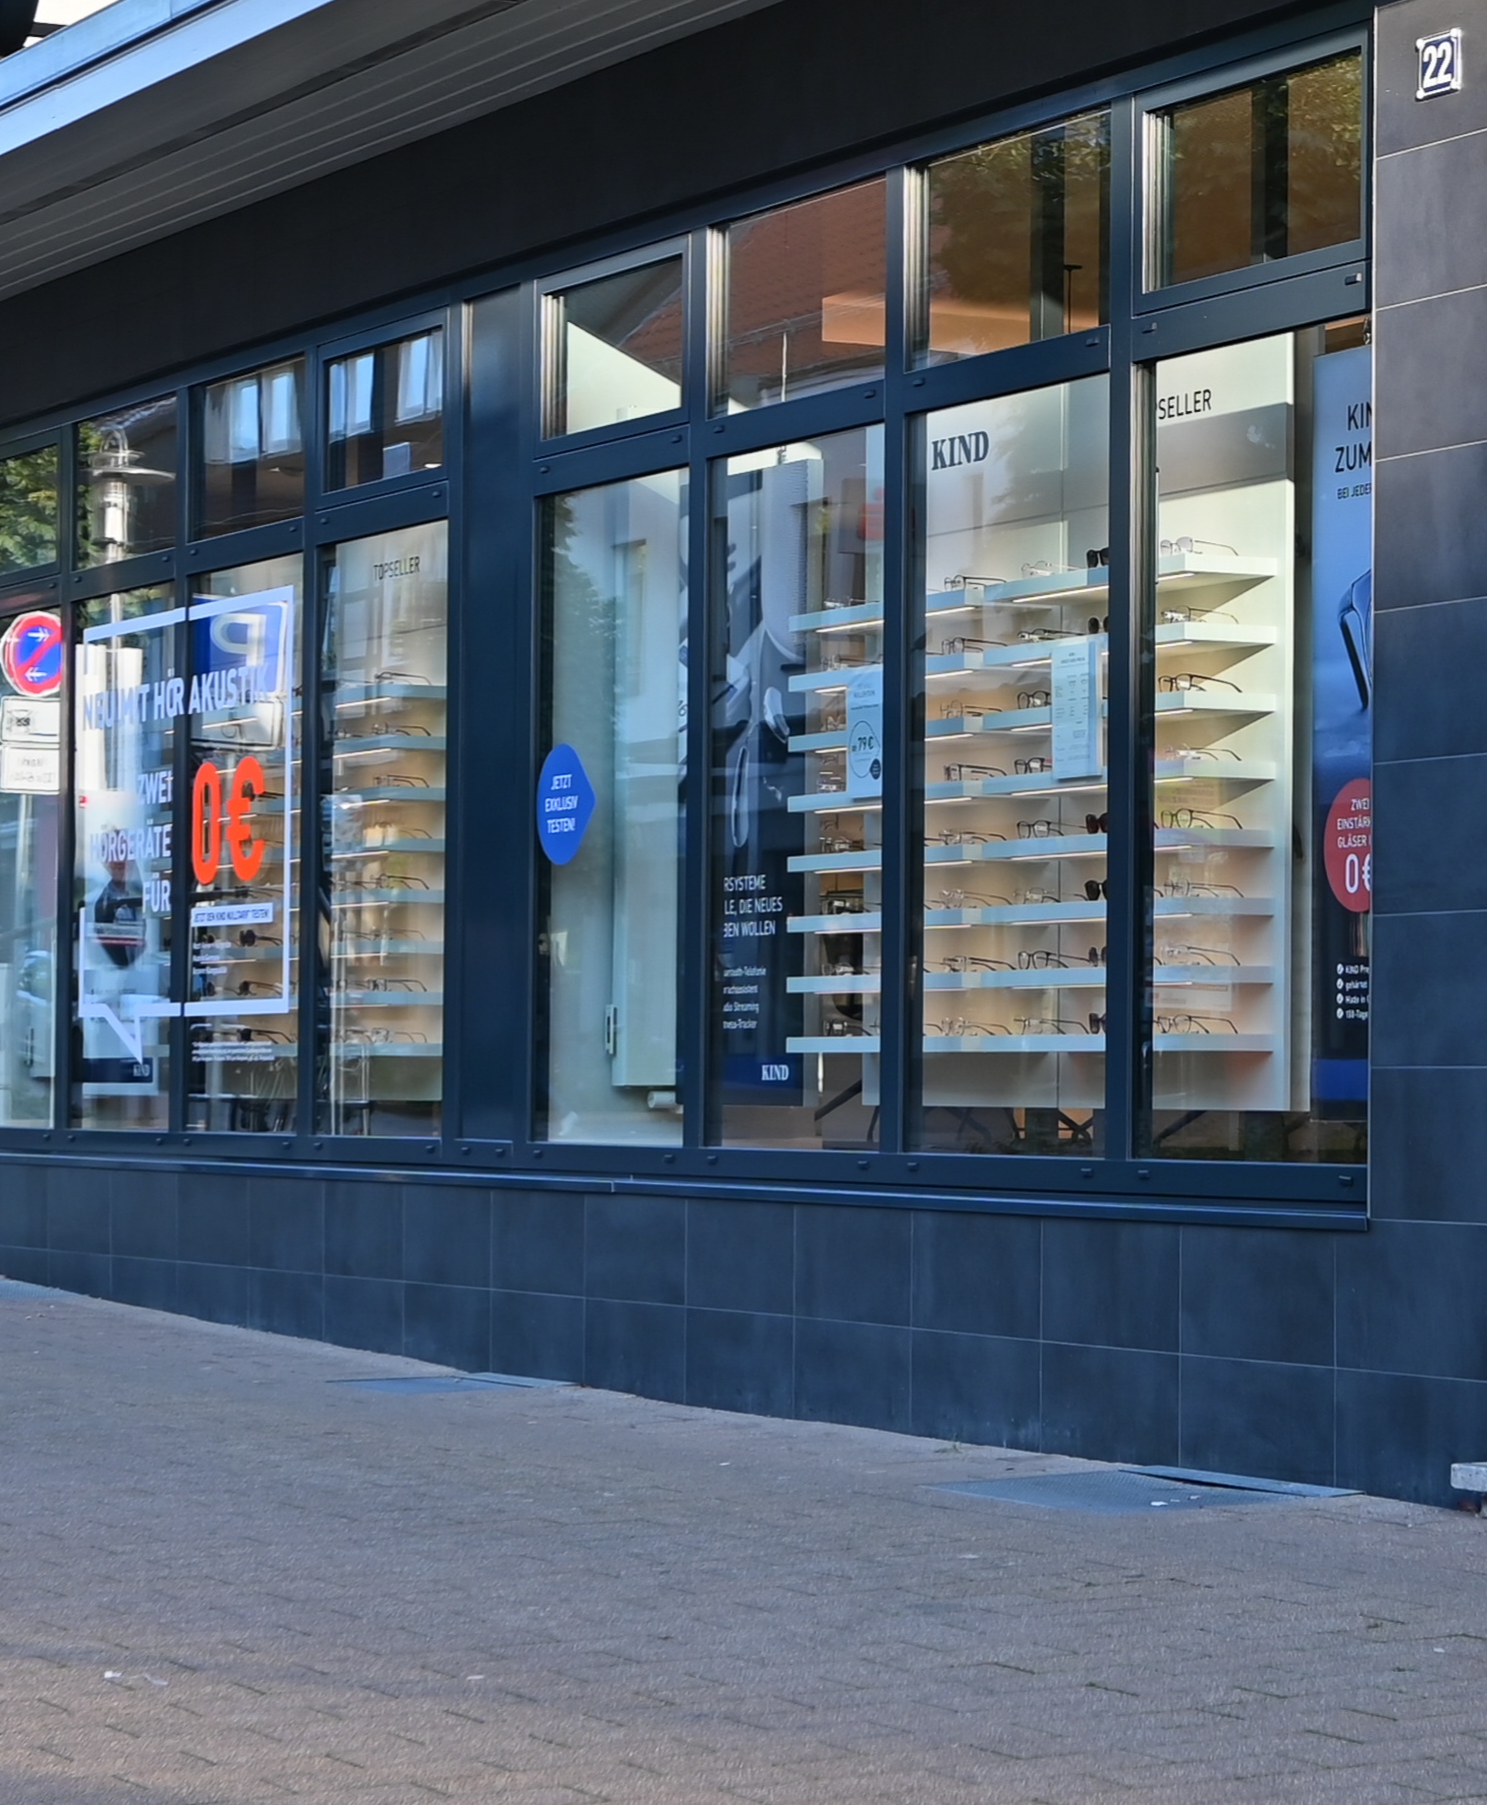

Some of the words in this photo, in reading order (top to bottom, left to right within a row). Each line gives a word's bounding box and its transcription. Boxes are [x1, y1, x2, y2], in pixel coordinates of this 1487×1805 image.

[1423, 41, 1453, 88] 22
[931, 430, 990, 471] KIND
[1334, 440, 1372, 473] ZUM
[373, 555, 421, 581] TOPSELLER
[82, 691, 113, 731] NEU
[137, 769, 173, 806] ZWEI
[550, 773, 573, 791] JETZT
[544, 795, 579, 813] EXKLUSIV
[89, 819, 172, 864] HÖRGERÄTE
[142, 872, 172, 915] FÜR
[754, 896, 783, 913] NEUES
[741, 920, 776, 937] WOLLEN
[761, 1064, 790, 1082] KIND
